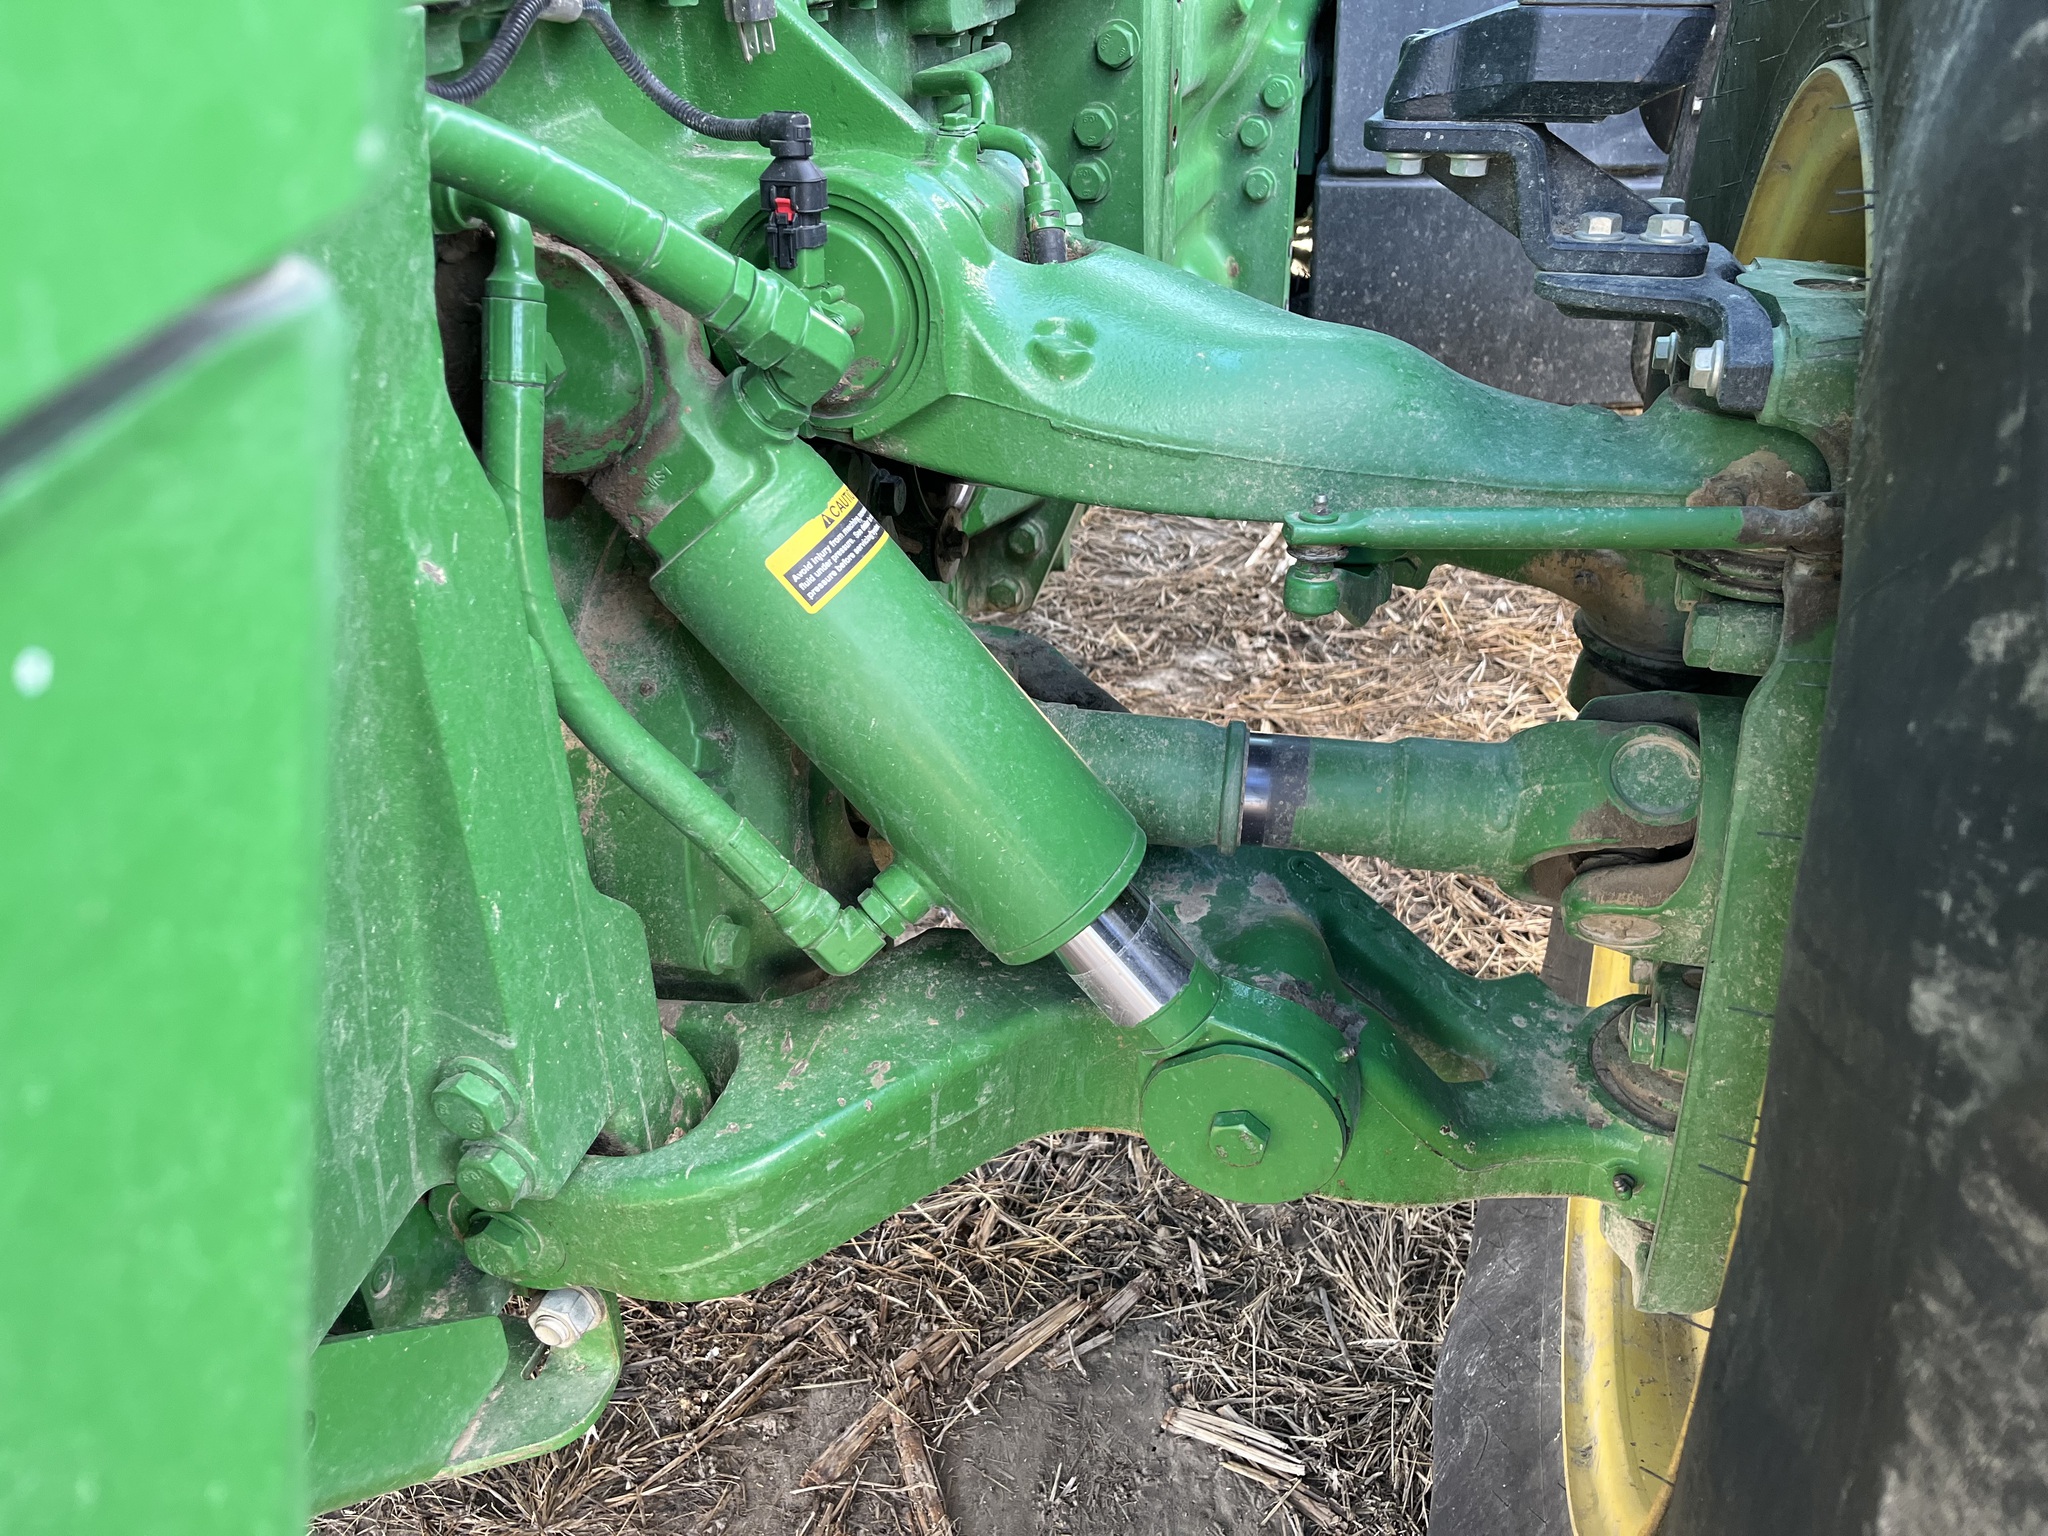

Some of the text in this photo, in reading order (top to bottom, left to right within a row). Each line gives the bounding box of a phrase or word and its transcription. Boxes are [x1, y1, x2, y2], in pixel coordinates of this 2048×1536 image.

[792, 560, 814, 582] Avoid
[810, 544, 832, 565] injury
[828, 532, 845, 548] from
[798, 573, 816, 591] fluid
[813, 558, 833, 578] under
[830, 538, 856, 563] pressure.
[806, 570, 838, 601] pressure
[834, 552, 856, 572] before
